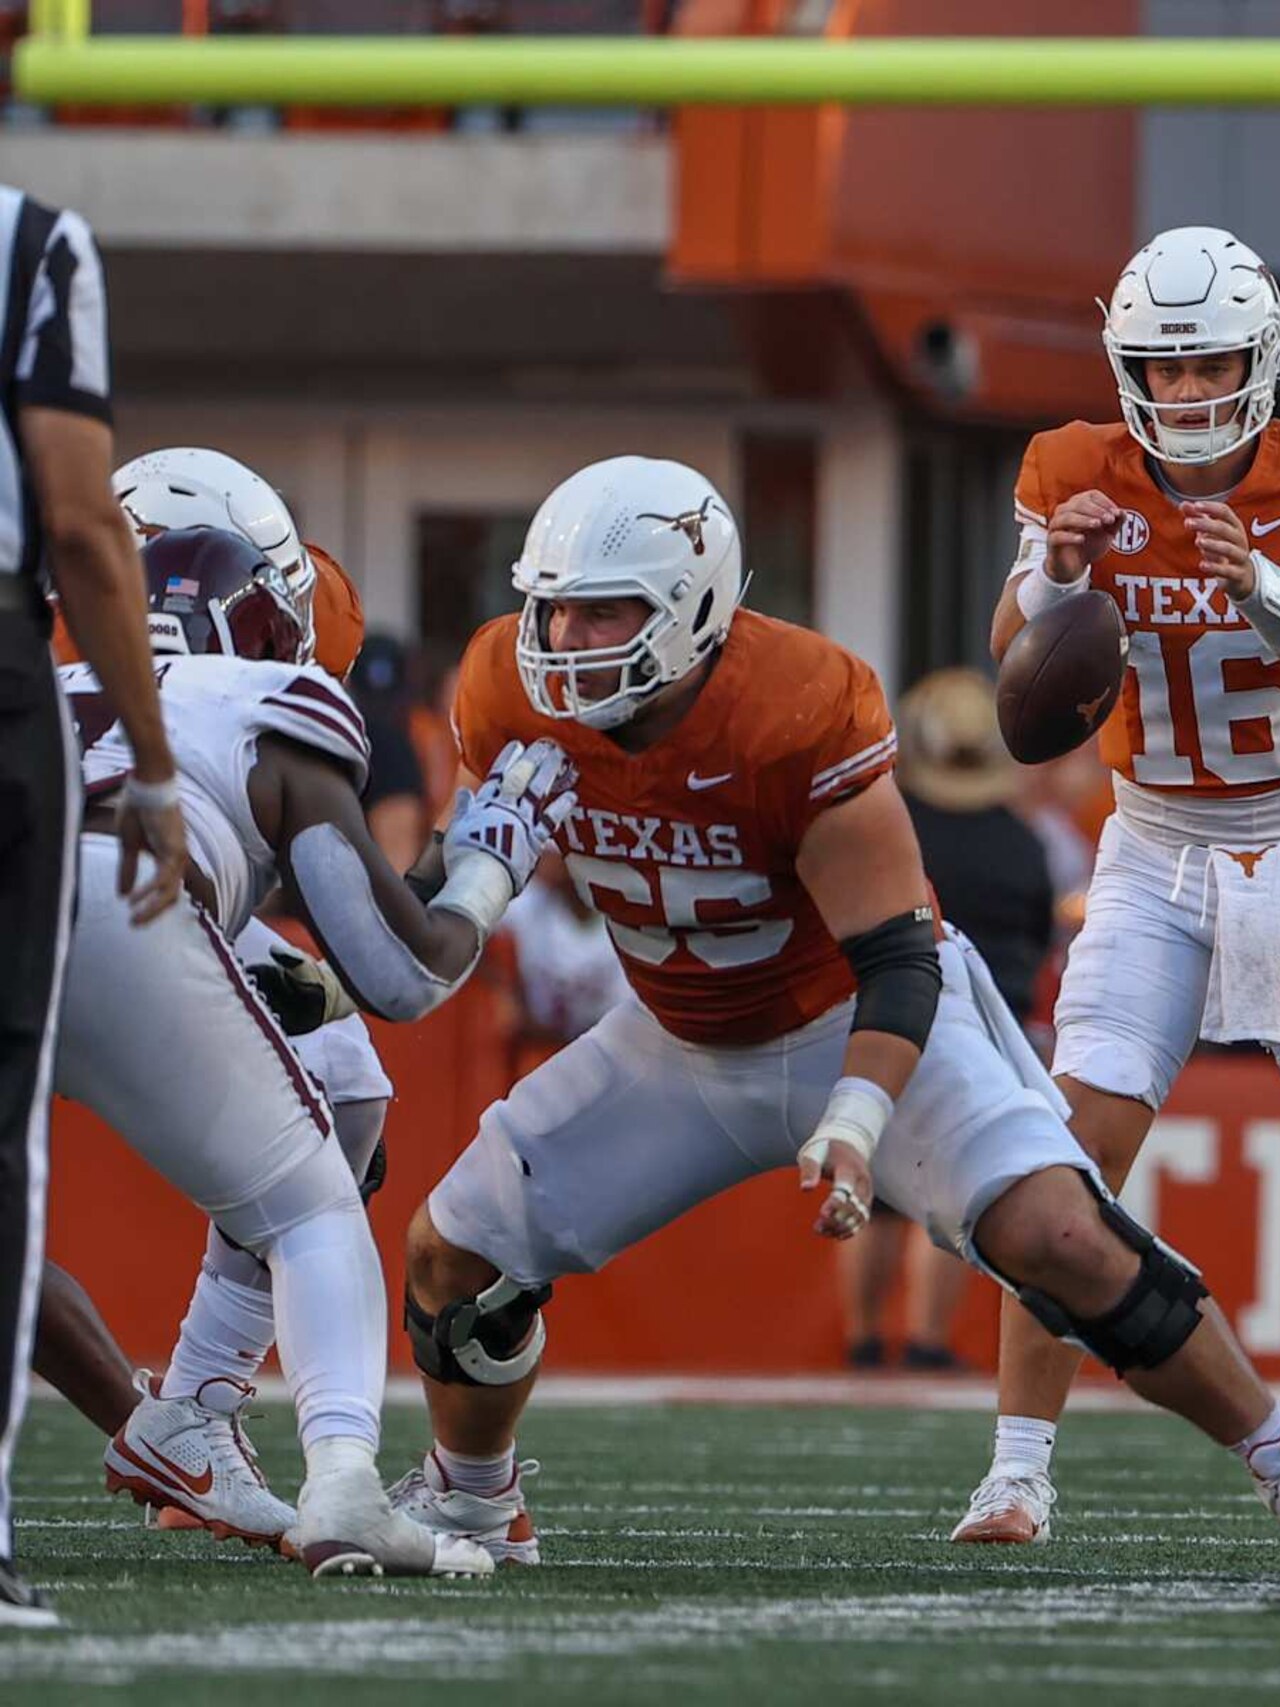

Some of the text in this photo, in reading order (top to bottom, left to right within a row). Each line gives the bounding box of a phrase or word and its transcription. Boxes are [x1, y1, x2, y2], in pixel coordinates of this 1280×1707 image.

[1160, 322, 1198, 335] HORNS
[1113, 512, 1147, 550] EC
[1114, 573, 1242, 624] TEX
[562, 806, 743, 866] TEXAS
